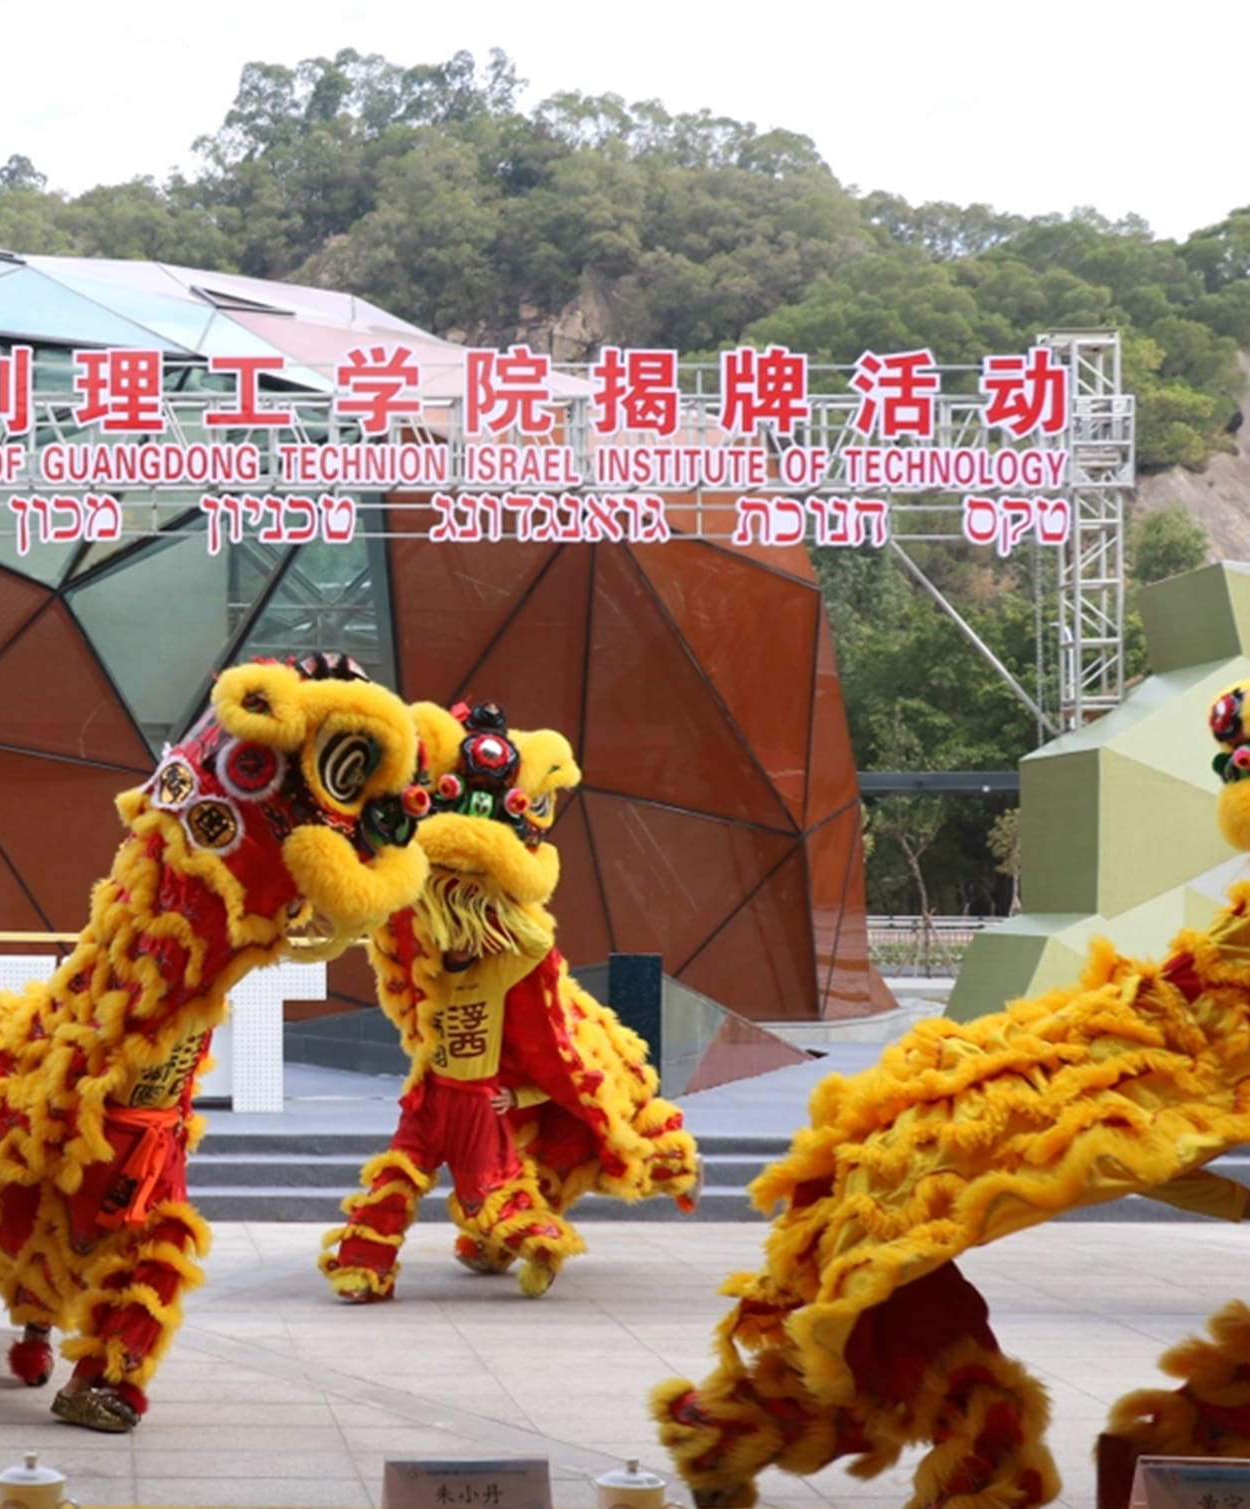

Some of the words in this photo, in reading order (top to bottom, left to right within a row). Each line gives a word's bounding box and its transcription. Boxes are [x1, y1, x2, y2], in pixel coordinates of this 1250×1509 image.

[44, 445, 258, 481] GUANGDONG
[280, 446, 446, 481] TECHNION
[468, 447, 580, 483] ISRAEL
[599, 449, 765, 484] INSTITUTE
[785, 450, 826, 484] OF
[845, 450, 1066, 485] TECHNOLOGY
[11, 496, 119, 552] מכון
[202, 496, 353, 552] טכניון
[433, 496, 669, 540] גואנגדונג
[736, 499, 888, 545] חנוכת
[967, 499, 1068, 554] טקס
